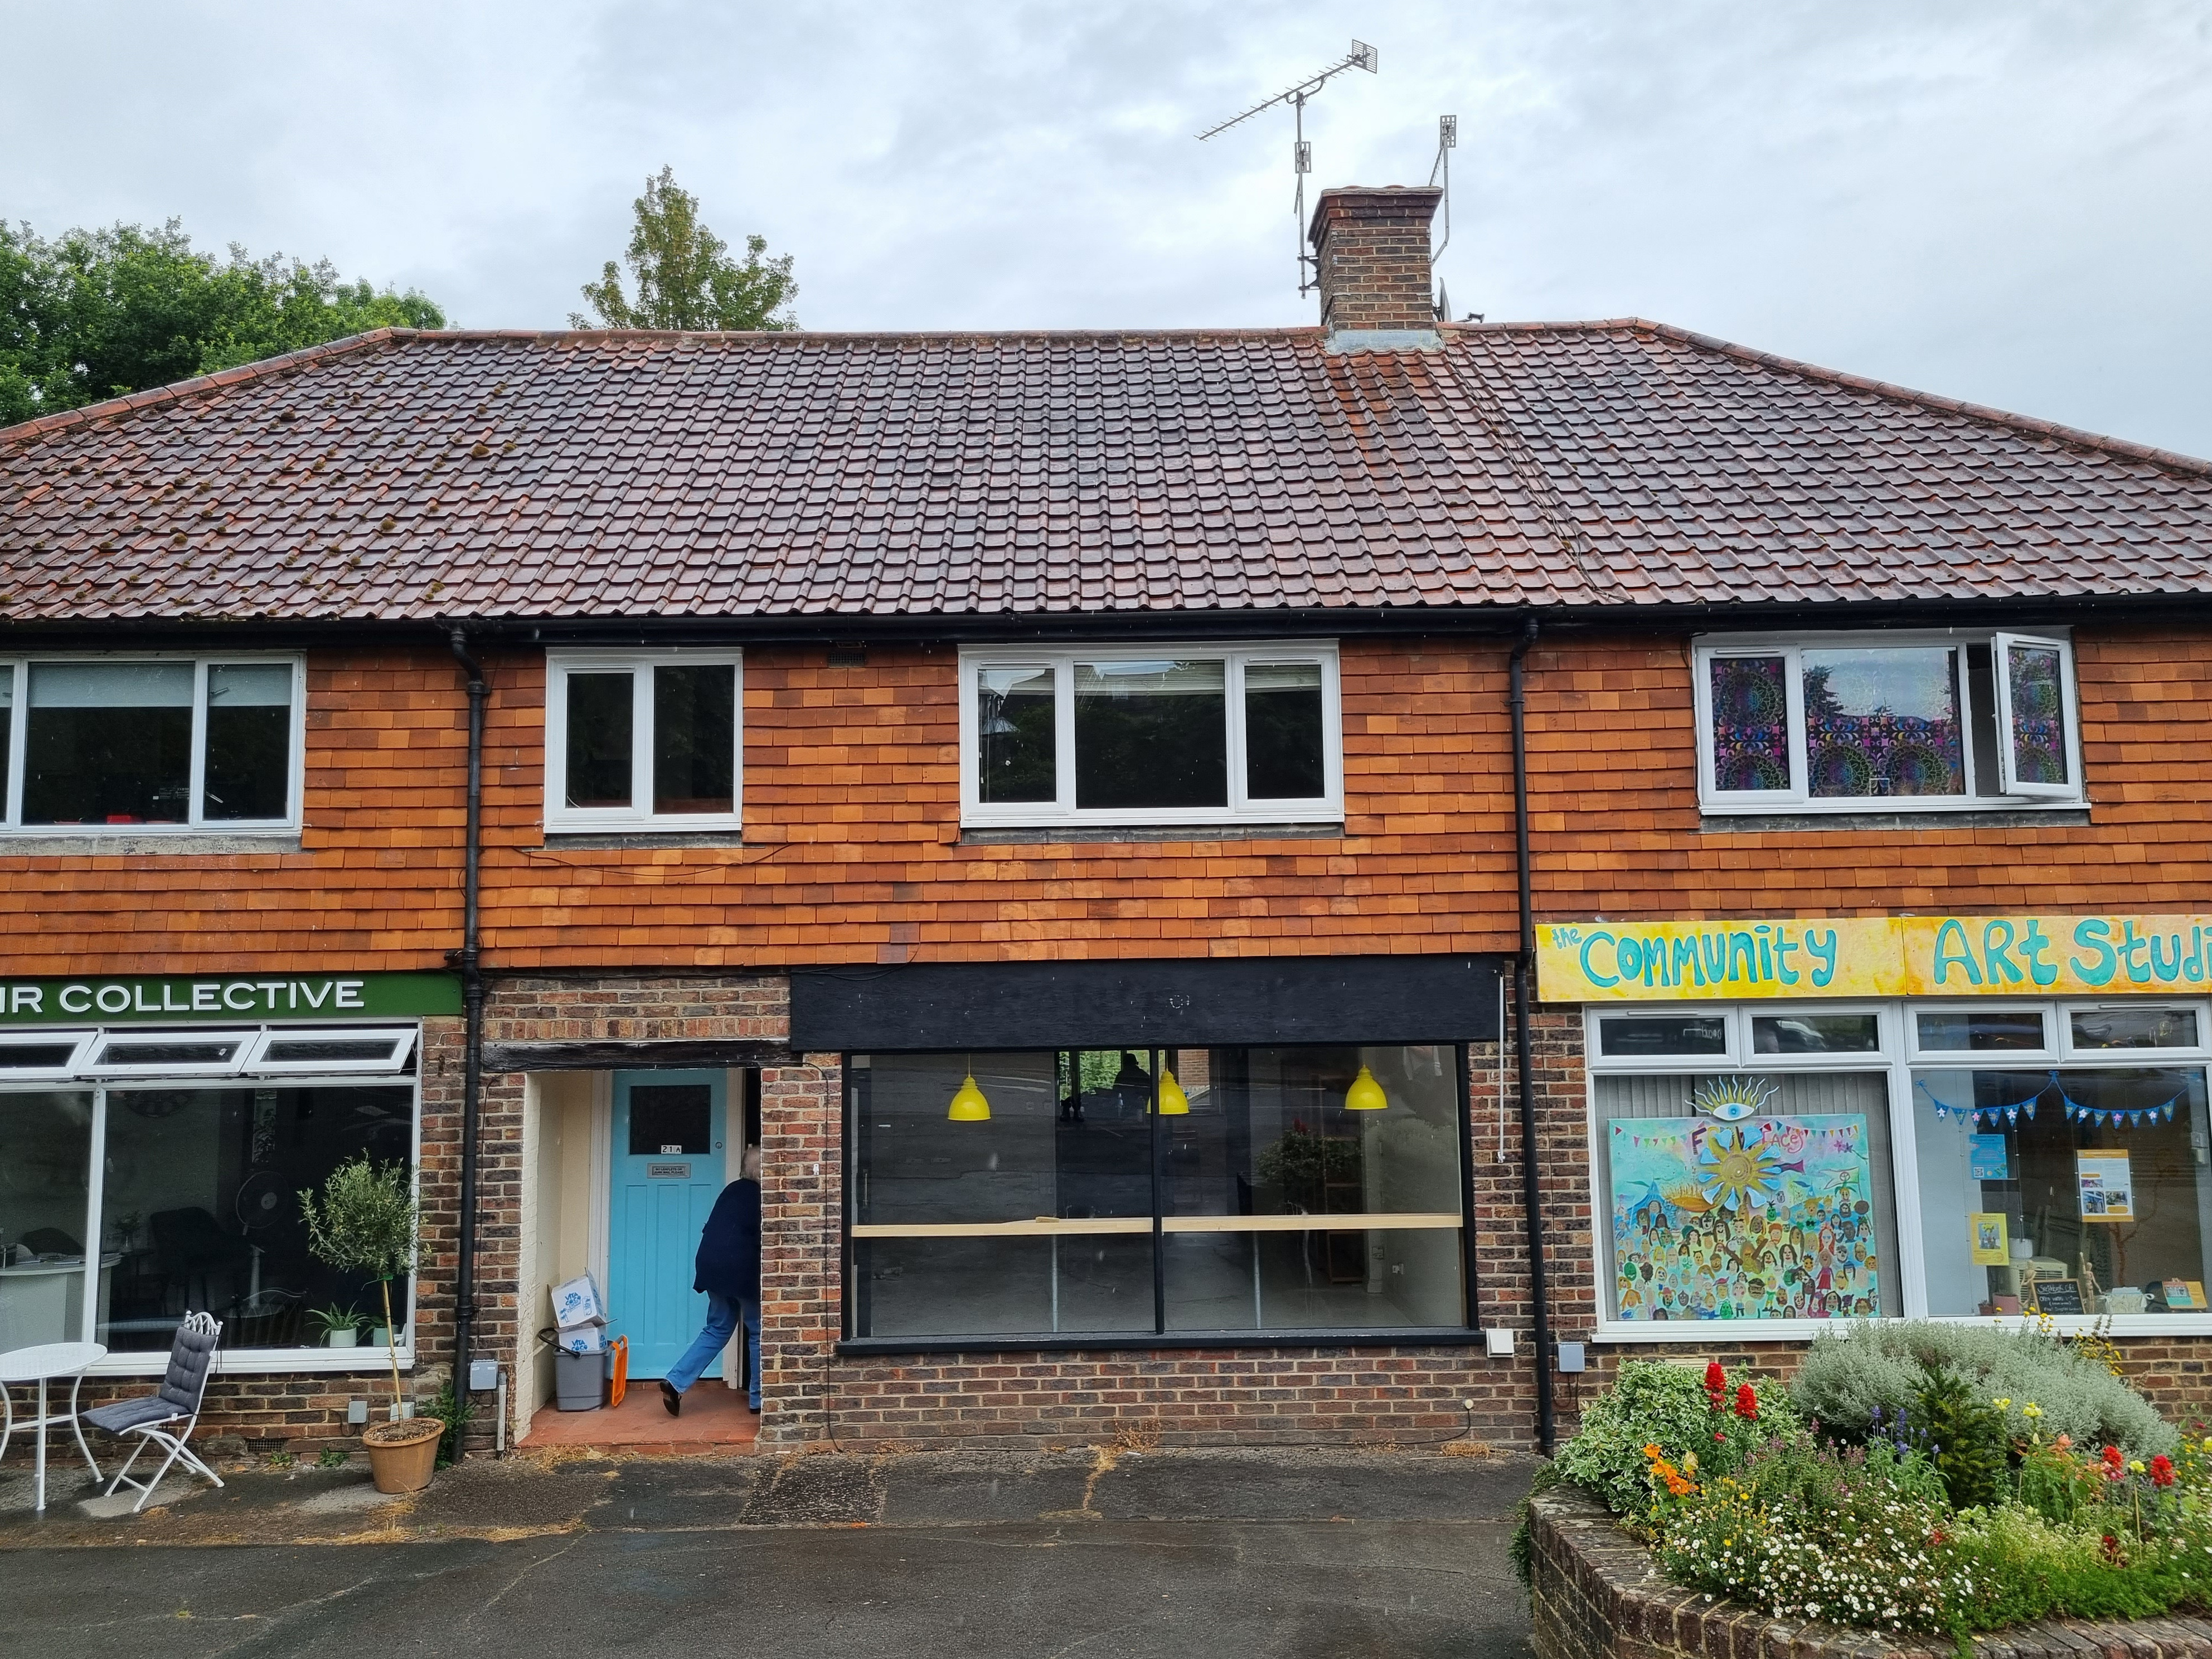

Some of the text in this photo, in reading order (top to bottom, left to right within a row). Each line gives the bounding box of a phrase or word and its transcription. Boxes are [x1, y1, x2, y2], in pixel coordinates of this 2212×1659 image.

[1551, 927, 1582, 949] the
[59, 981, 365, 1013] COLLECTIVE
[565, 1292, 579, 1301] VITA
